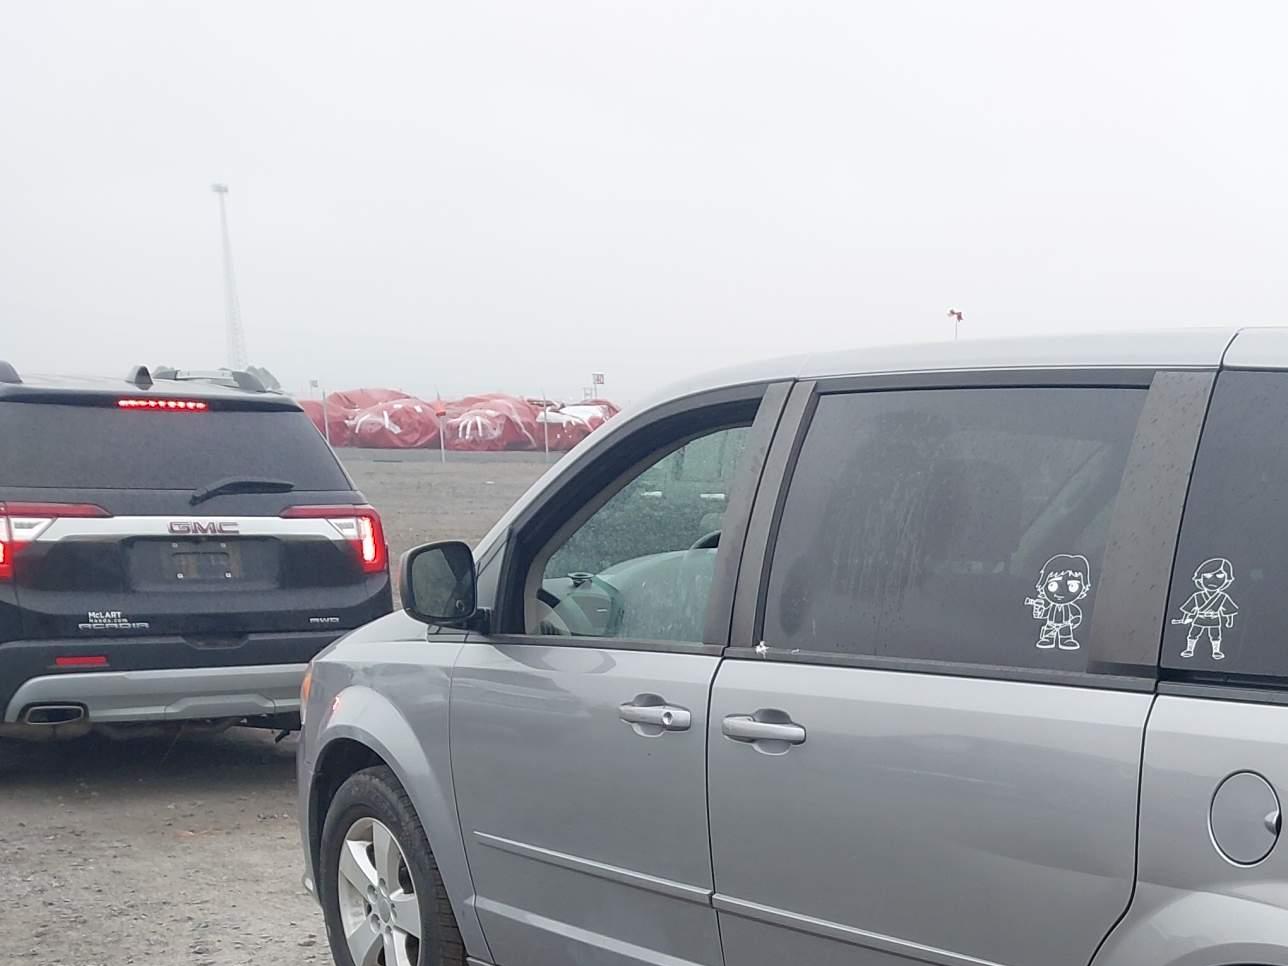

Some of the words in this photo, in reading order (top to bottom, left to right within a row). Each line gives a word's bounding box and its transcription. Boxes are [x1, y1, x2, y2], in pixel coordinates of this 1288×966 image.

[168, 521, 240, 535] GMC
[309, 616, 340, 624] AWD
[78, 622, 149, 630] ACADIA
